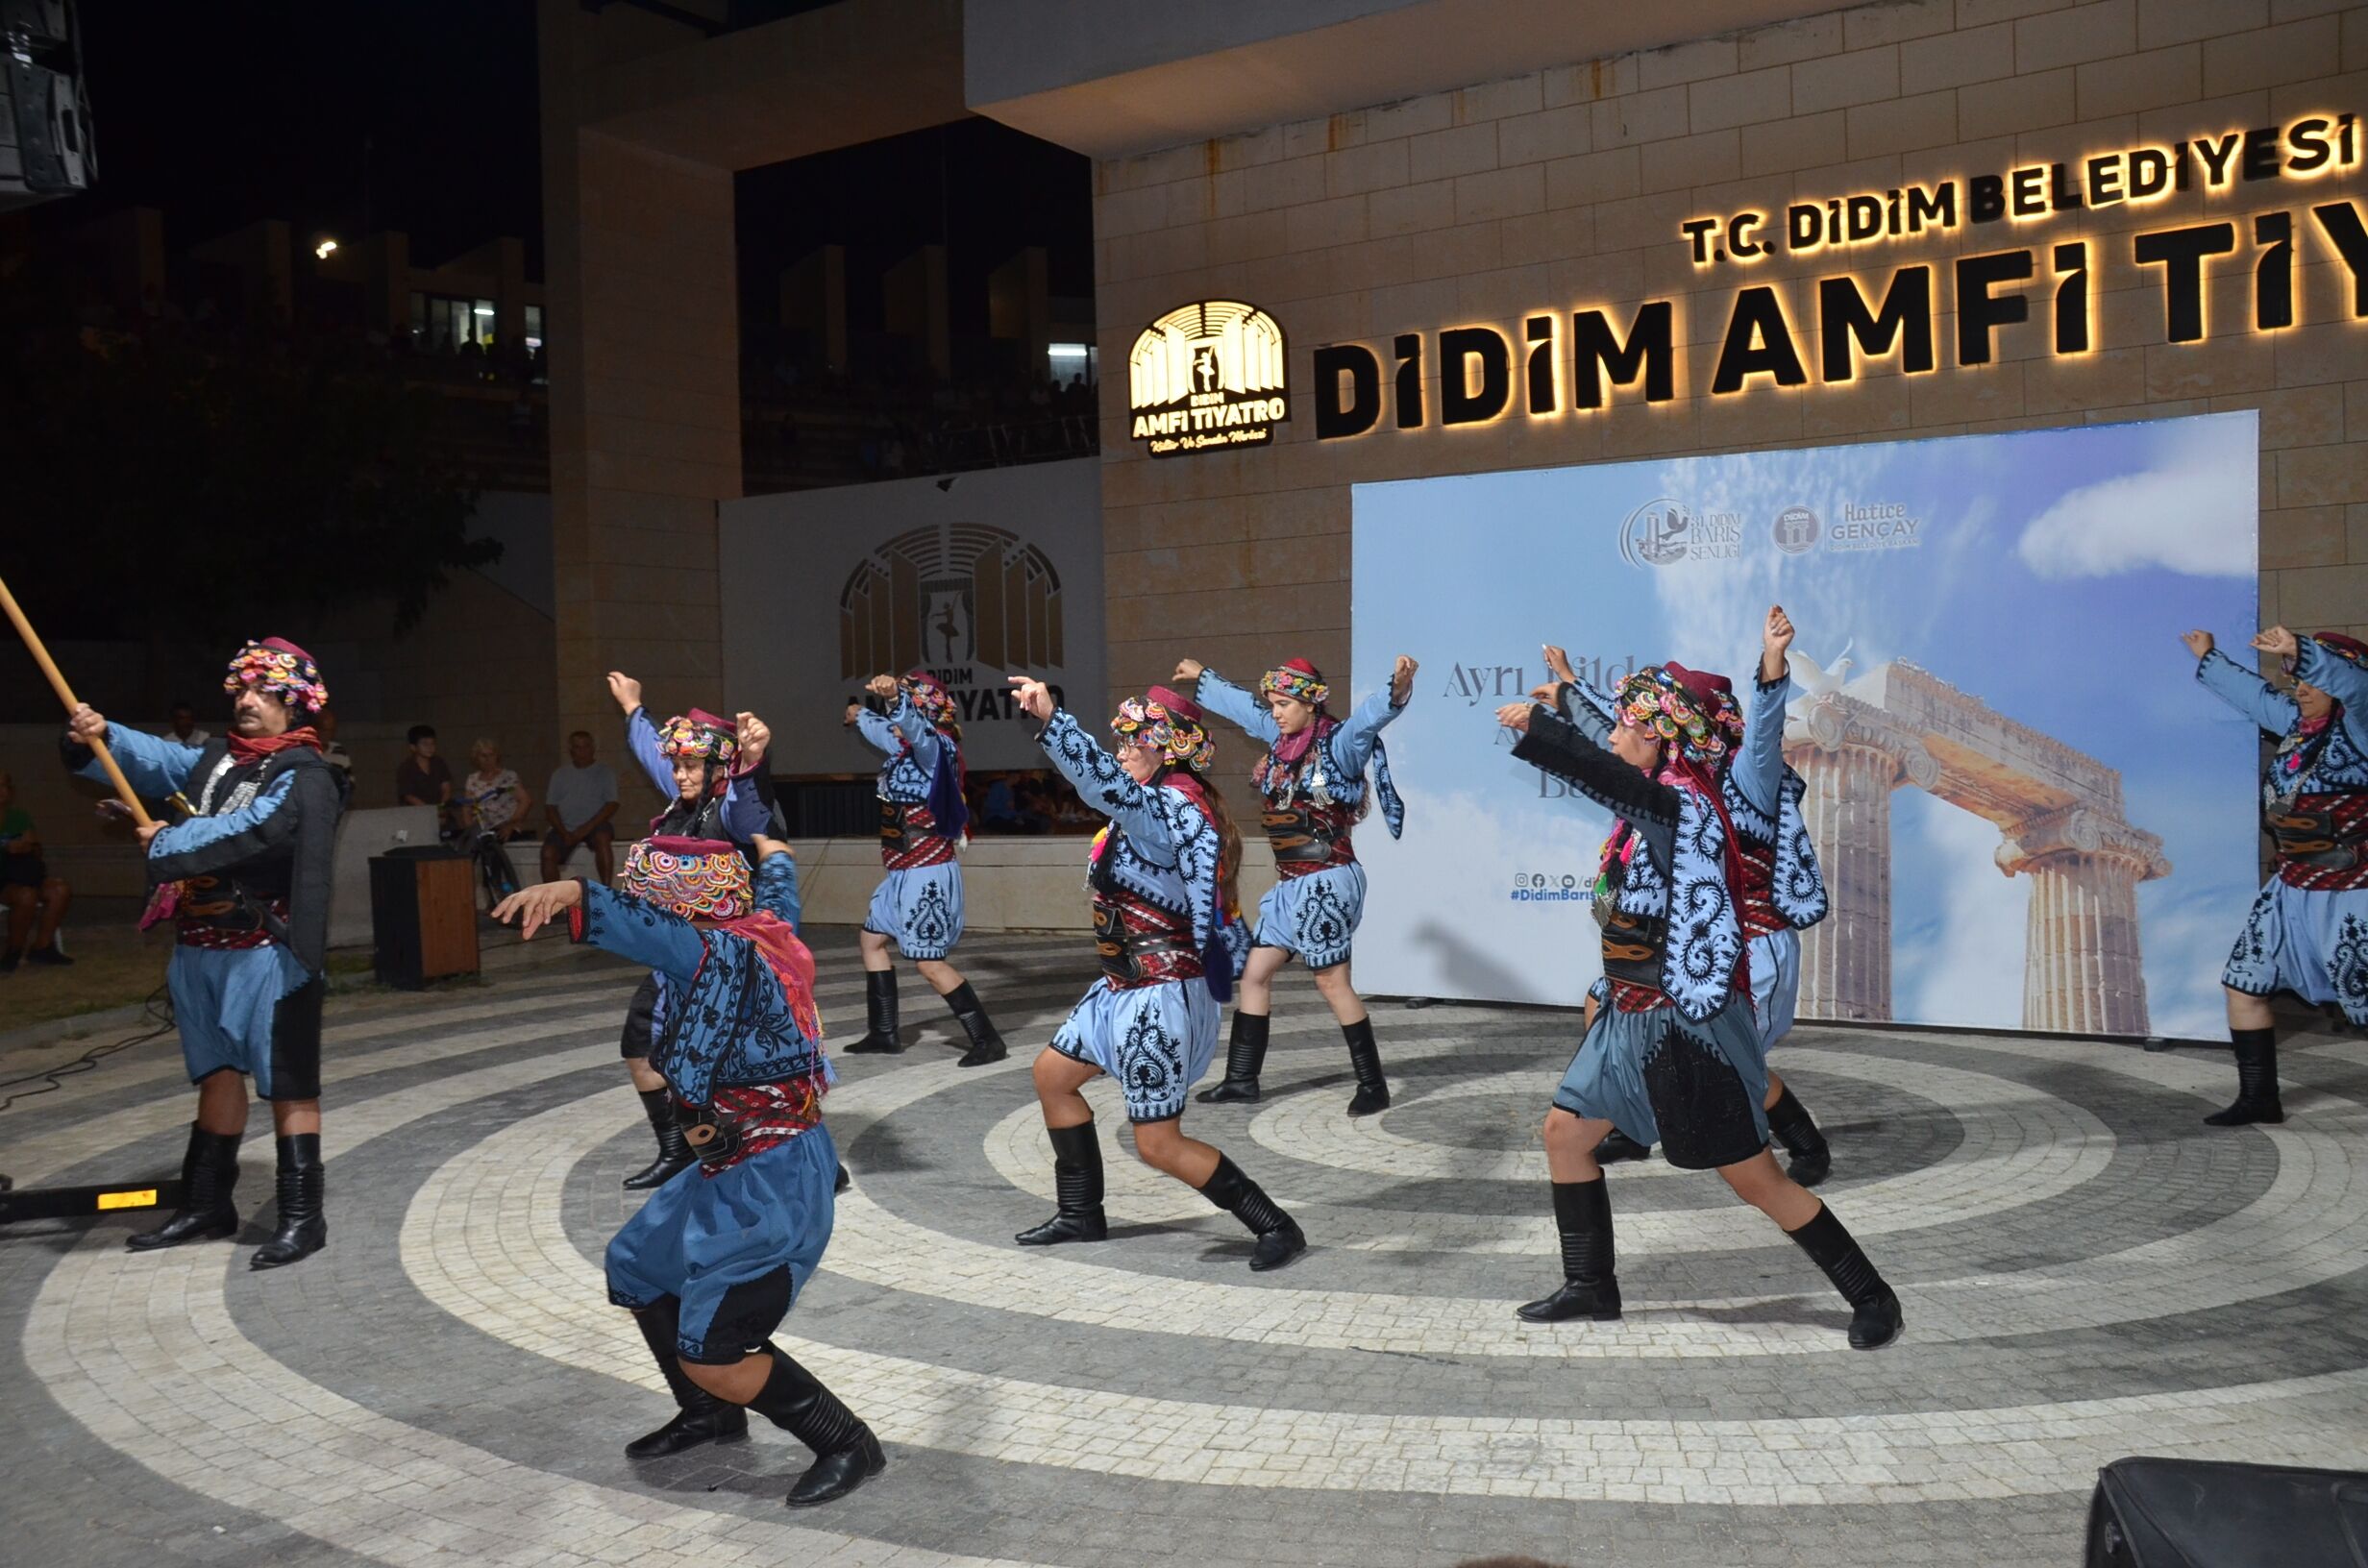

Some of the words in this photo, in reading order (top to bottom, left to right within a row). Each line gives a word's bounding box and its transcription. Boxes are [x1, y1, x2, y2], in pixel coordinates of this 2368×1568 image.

[1682, 212, 1775, 264] T.C.
[1788, 181, 1957, 250] DİDİM
[1970, 112, 2356, 224] BELEDİYESİ
[1313, 301, 1675, 440] DİDİM
[1711, 240, 2089, 395] AMFİ
[1831, 519, 1918, 540] GENÇAY
[1844, 502, 1905, 523] Hatice
[1443, 661, 1524, 707] Ayrı
